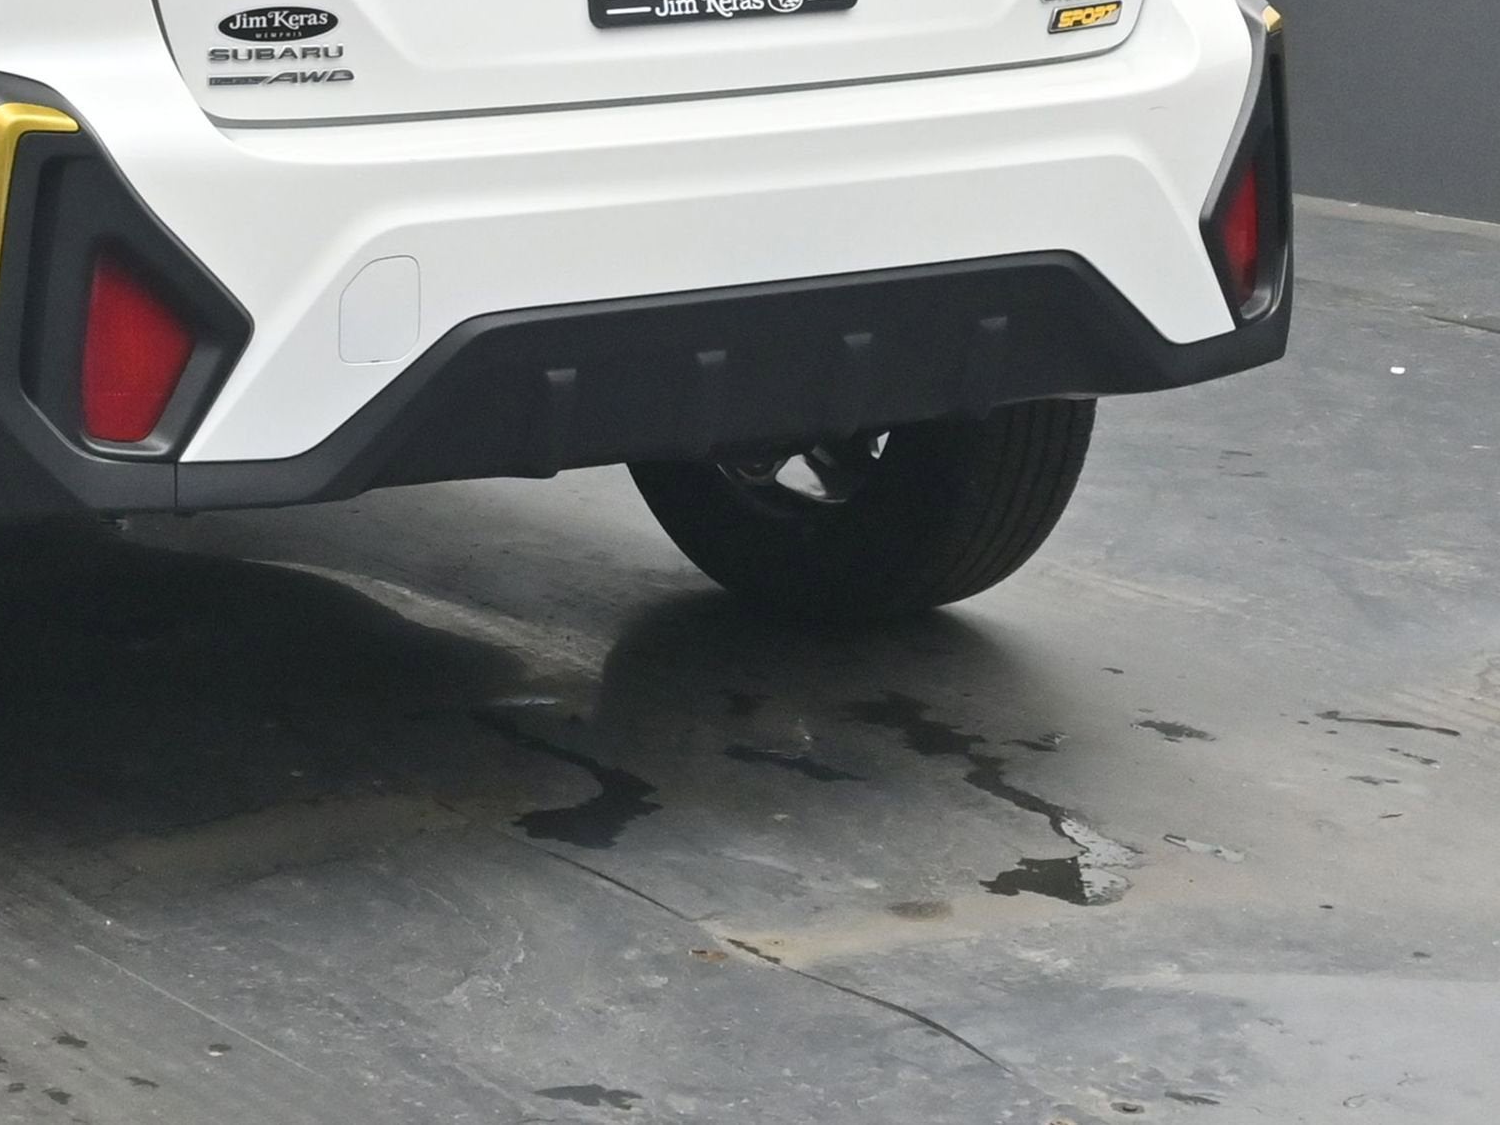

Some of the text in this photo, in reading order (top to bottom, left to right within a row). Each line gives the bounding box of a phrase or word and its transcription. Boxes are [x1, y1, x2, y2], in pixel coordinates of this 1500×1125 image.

[229, 10, 329, 30] Jim Keras
[1058, 3, 1118, 28] SPORT
[255, 31, 303, 39] MEMPHIS
[208, 44, 344, 62] SUBARU
[267, 69, 355, 85] AWD
